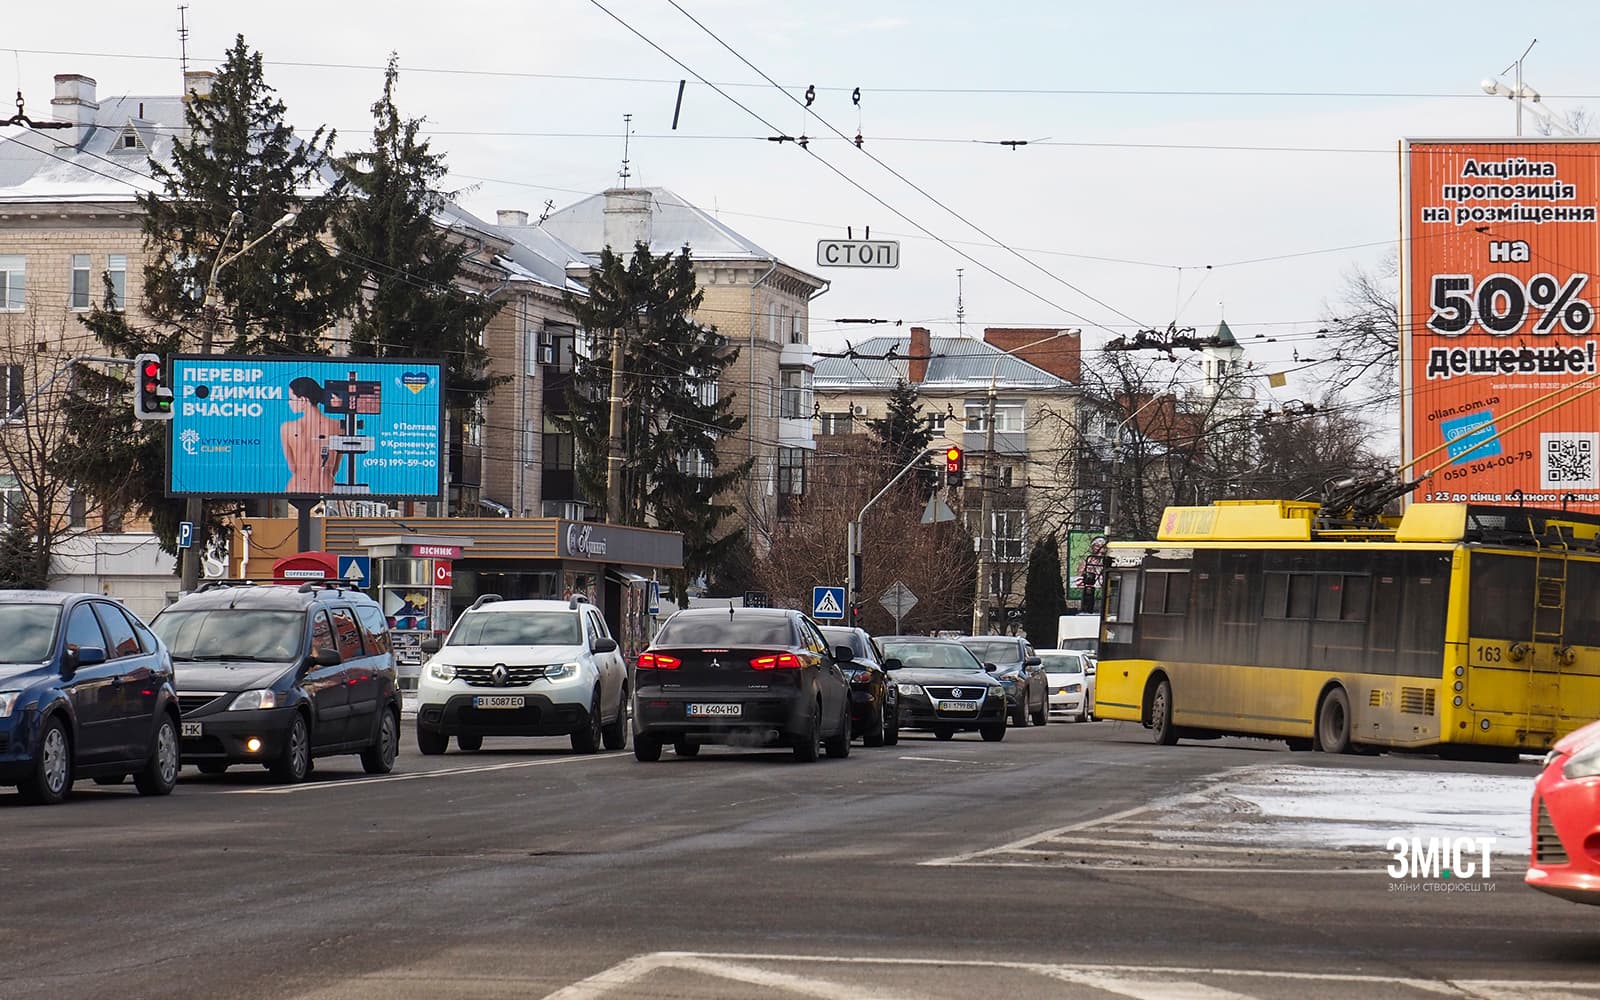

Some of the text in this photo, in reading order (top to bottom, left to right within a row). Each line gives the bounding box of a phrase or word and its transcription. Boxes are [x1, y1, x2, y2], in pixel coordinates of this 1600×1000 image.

[1462, 157, 1556, 179] Акційна
[1442, 181, 1577, 202] пропозиція
[1422, 203, 1597, 225] на розміщення
[825, 244, 891, 264] СТОП
[1488, 239, 1531, 263] на
[1427, 273, 1595, 336] 50%
[1426, 340, 1597, 380] дешевше!
[183, 367, 264, 382] ПЕРЕВІР
[182, 402, 264, 418] ВЧАСНО
[1427, 397, 1501, 421] ollan.com.ua
[399, 422, 436, 431] Полтава
[200, 445, 231, 453] CLINIC
[201, 438, 261, 446] LYTVYNENKO
[363, 458, 436, 468] (095) 199-59-00
[1443, 450, 1533, 481] 050 304-00-79
[1435, 491, 1450, 502] 23
[1452, 493, 1467, 503] до
[1470, 491, 1502, 503] кінця
[419, 546, 453, 556] ВІСНИК
[1477, 645, 1502, 662] 163
